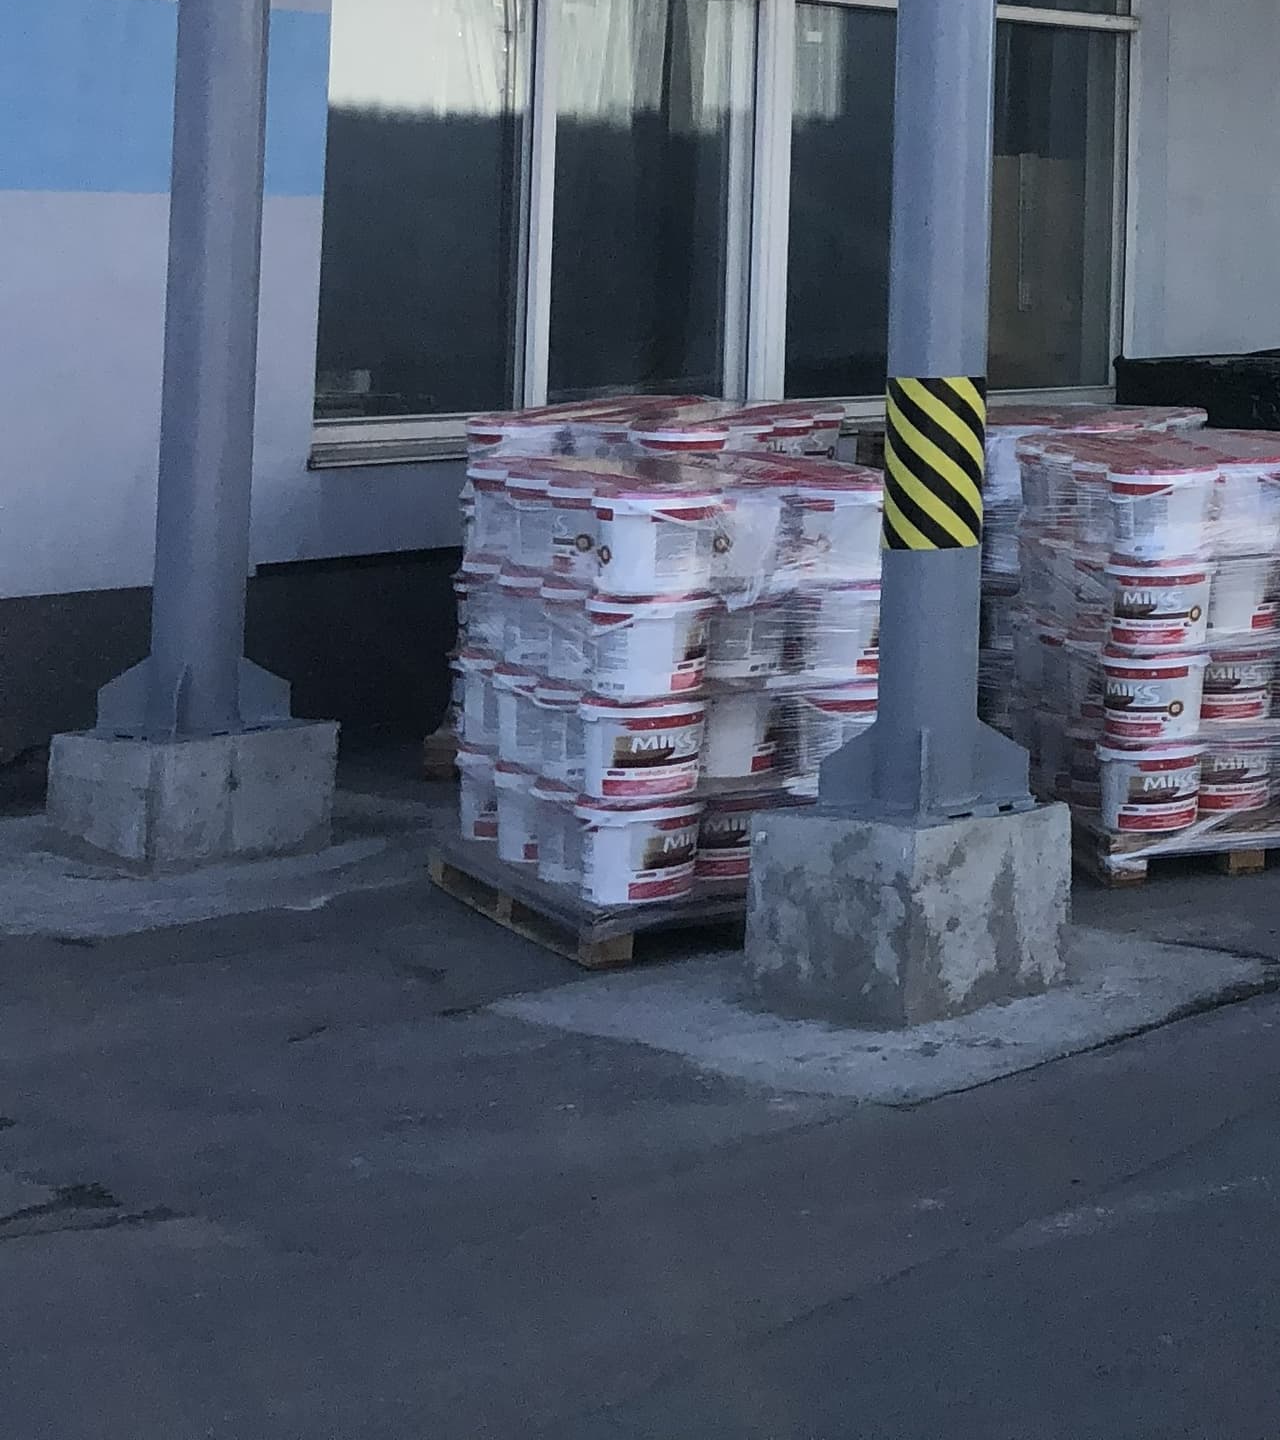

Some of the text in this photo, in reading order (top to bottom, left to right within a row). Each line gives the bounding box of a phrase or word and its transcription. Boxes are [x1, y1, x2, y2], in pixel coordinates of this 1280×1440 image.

[1122, 591, 1184, 610] MIKS
[1106, 682, 1161, 705] MIKS
[631, 729, 697, 753] MIKS
